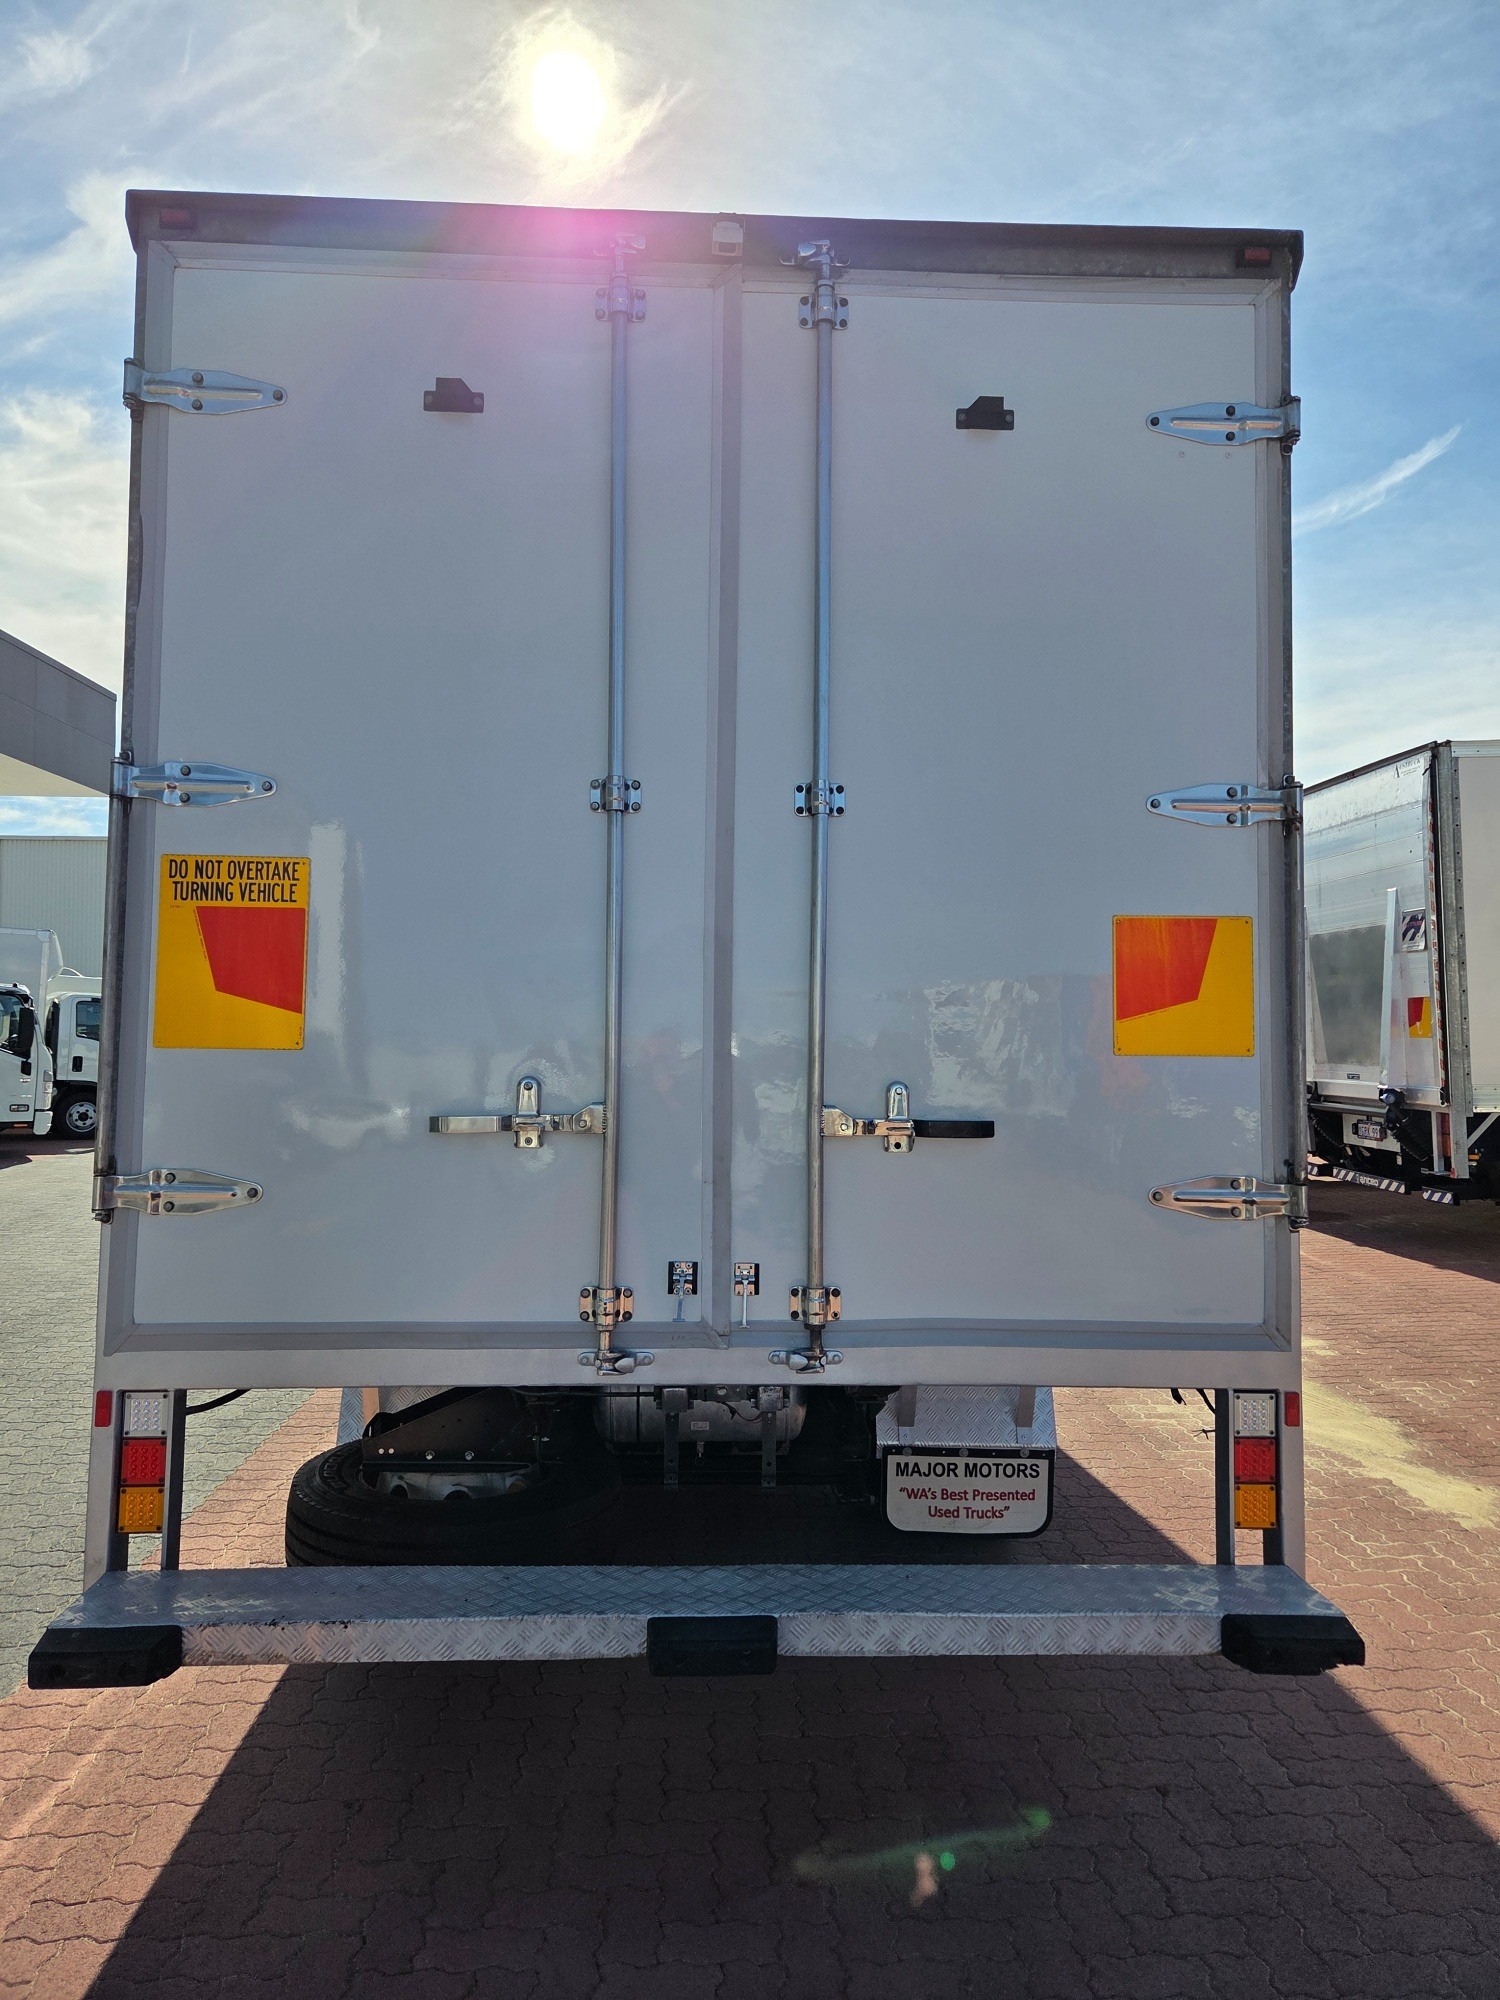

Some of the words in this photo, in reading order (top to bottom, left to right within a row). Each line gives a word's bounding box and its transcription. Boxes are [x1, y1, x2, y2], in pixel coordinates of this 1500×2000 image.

[168, 859, 189, 879] DO
[194, 859, 223, 880] NOT
[227, 860, 300, 881] OVERTAKE
[172, 881, 234, 902] TURNING
[239, 882, 297, 903] VEHICLE
[895, 1462, 959, 1478] MAJOR
[964, 1463, 1040, 1479] MOTORS
[940, 1488, 969, 1501] Best
[972, 1488, 1036, 1501] Presented
[928, 1506, 960, 1519] Used
[963, 1506, 1010, 1519] Trucks”
